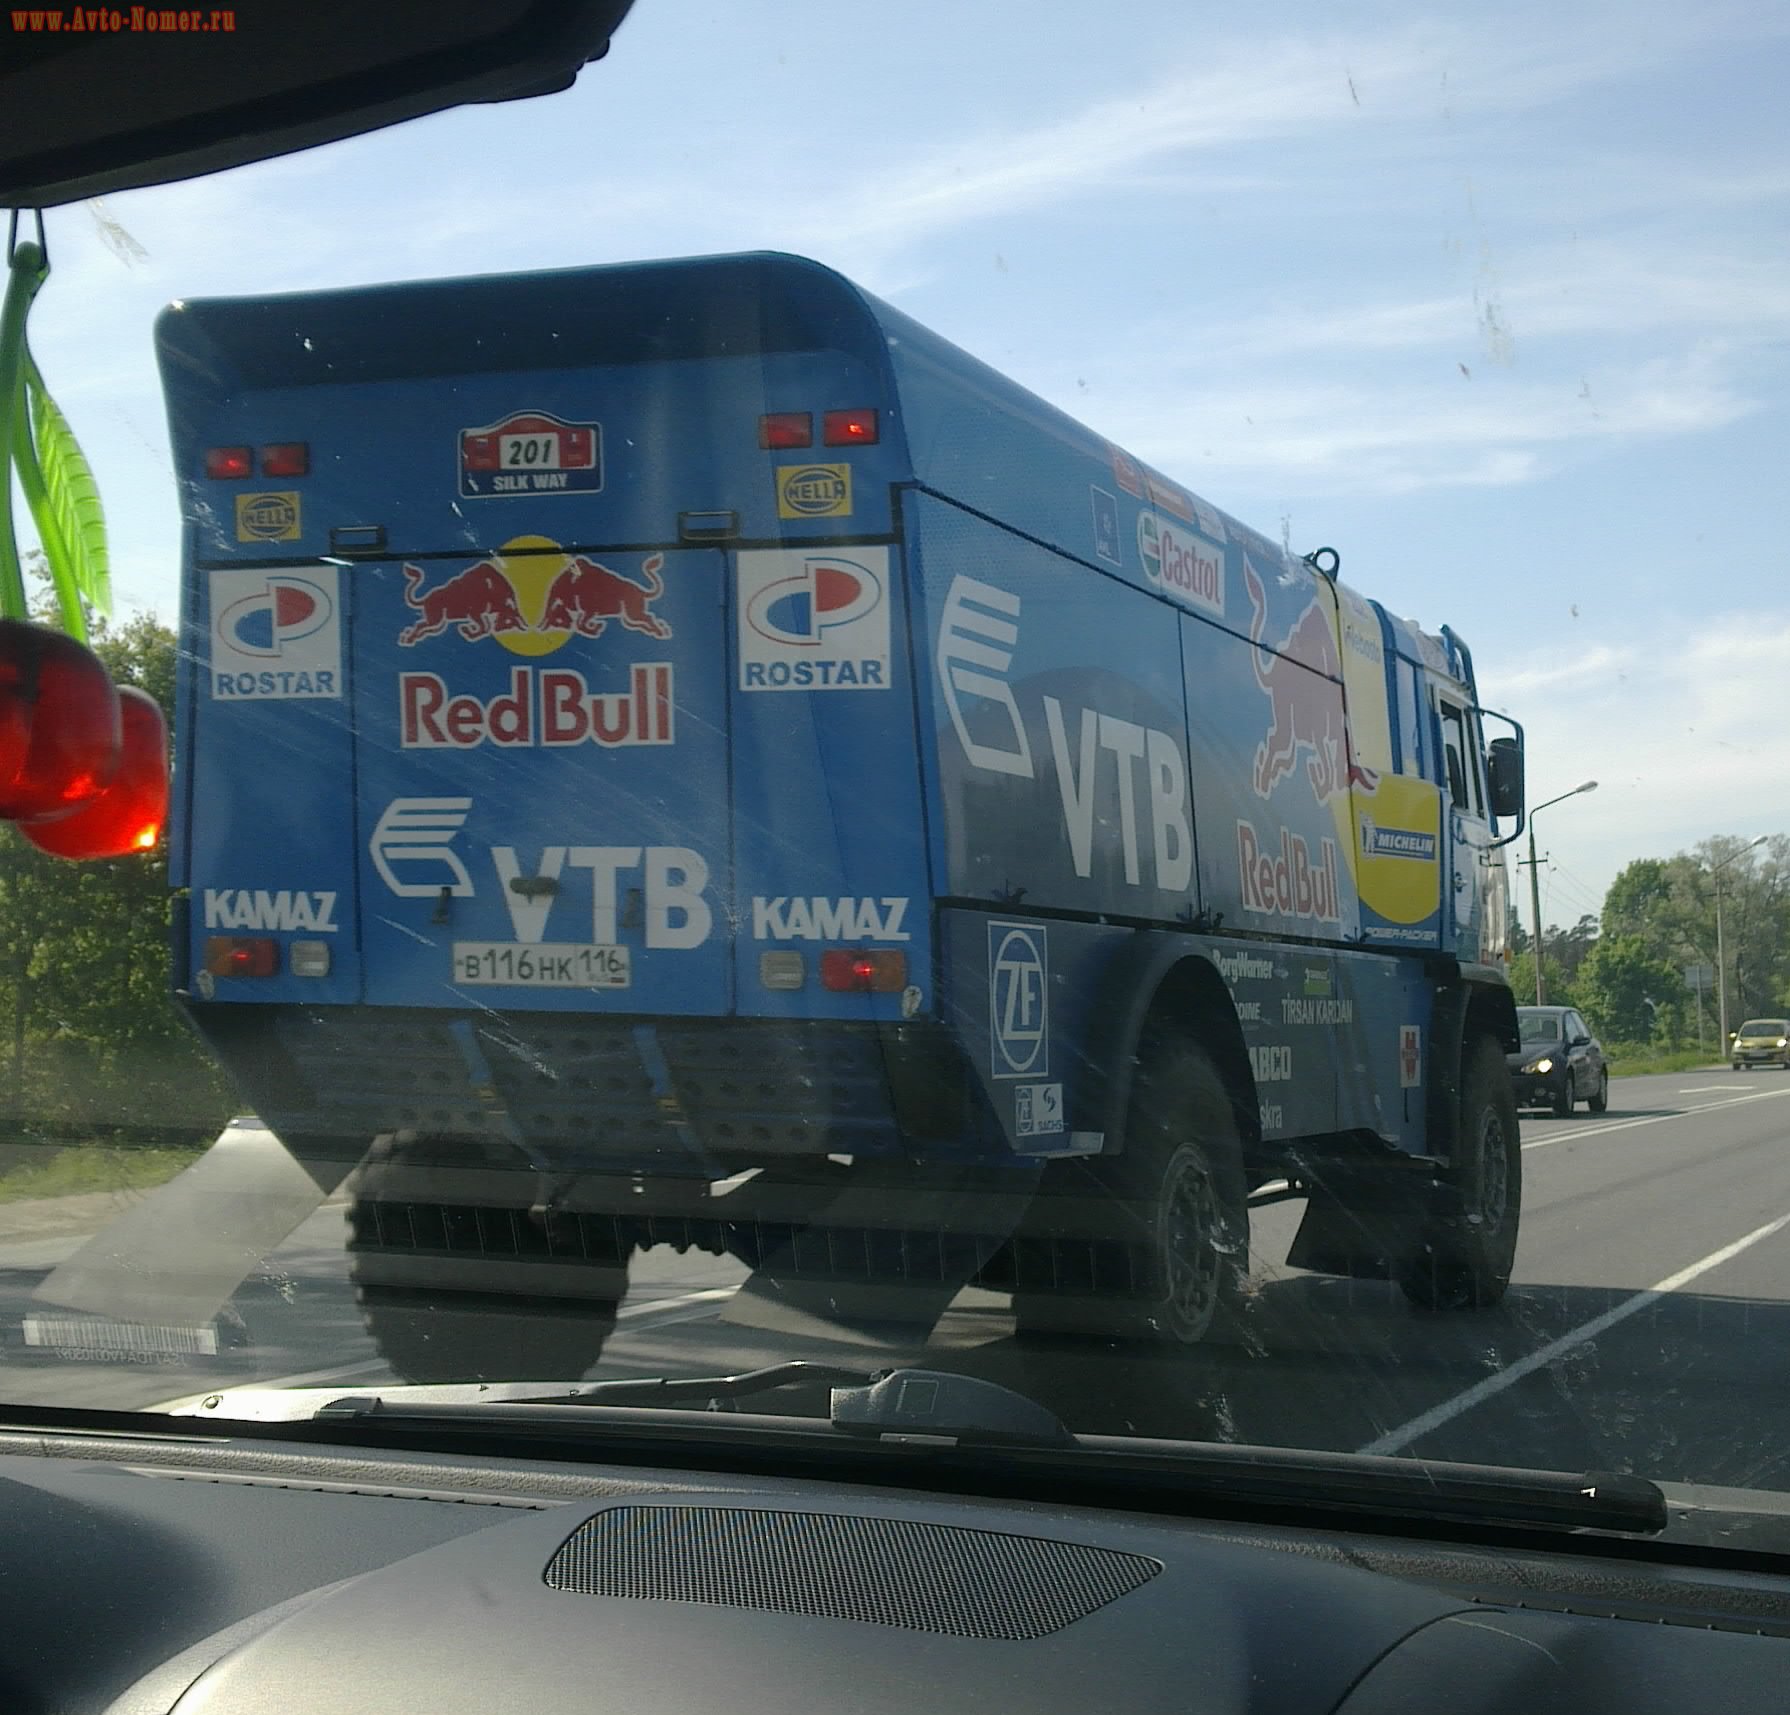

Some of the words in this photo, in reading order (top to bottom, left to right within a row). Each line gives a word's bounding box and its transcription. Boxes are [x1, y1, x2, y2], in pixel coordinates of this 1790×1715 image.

[509, 439, 552, 465] 201
[493, 474, 529, 491] SILK
[532, 473, 568, 490] WAY
[785, 479, 847, 501] HELLA
[1161, 530, 1221, 604] Castrol
[216, 669, 337, 695] ROSTAR
[744, 659, 884, 687] ROSTAR
[1043, 695, 1194, 892] VTB
[1377, 833, 1435, 854] MICHELIN
[204, 888, 339, 933] KAMAZ
[490, 846, 712, 950] VTB
[752, 896, 911, 942] KAMAZ
[996, 960, 1042, 1041] ZF
[1248, 1046, 1292, 1082] ABCO
[1260, 1097, 1283, 1130] skra
